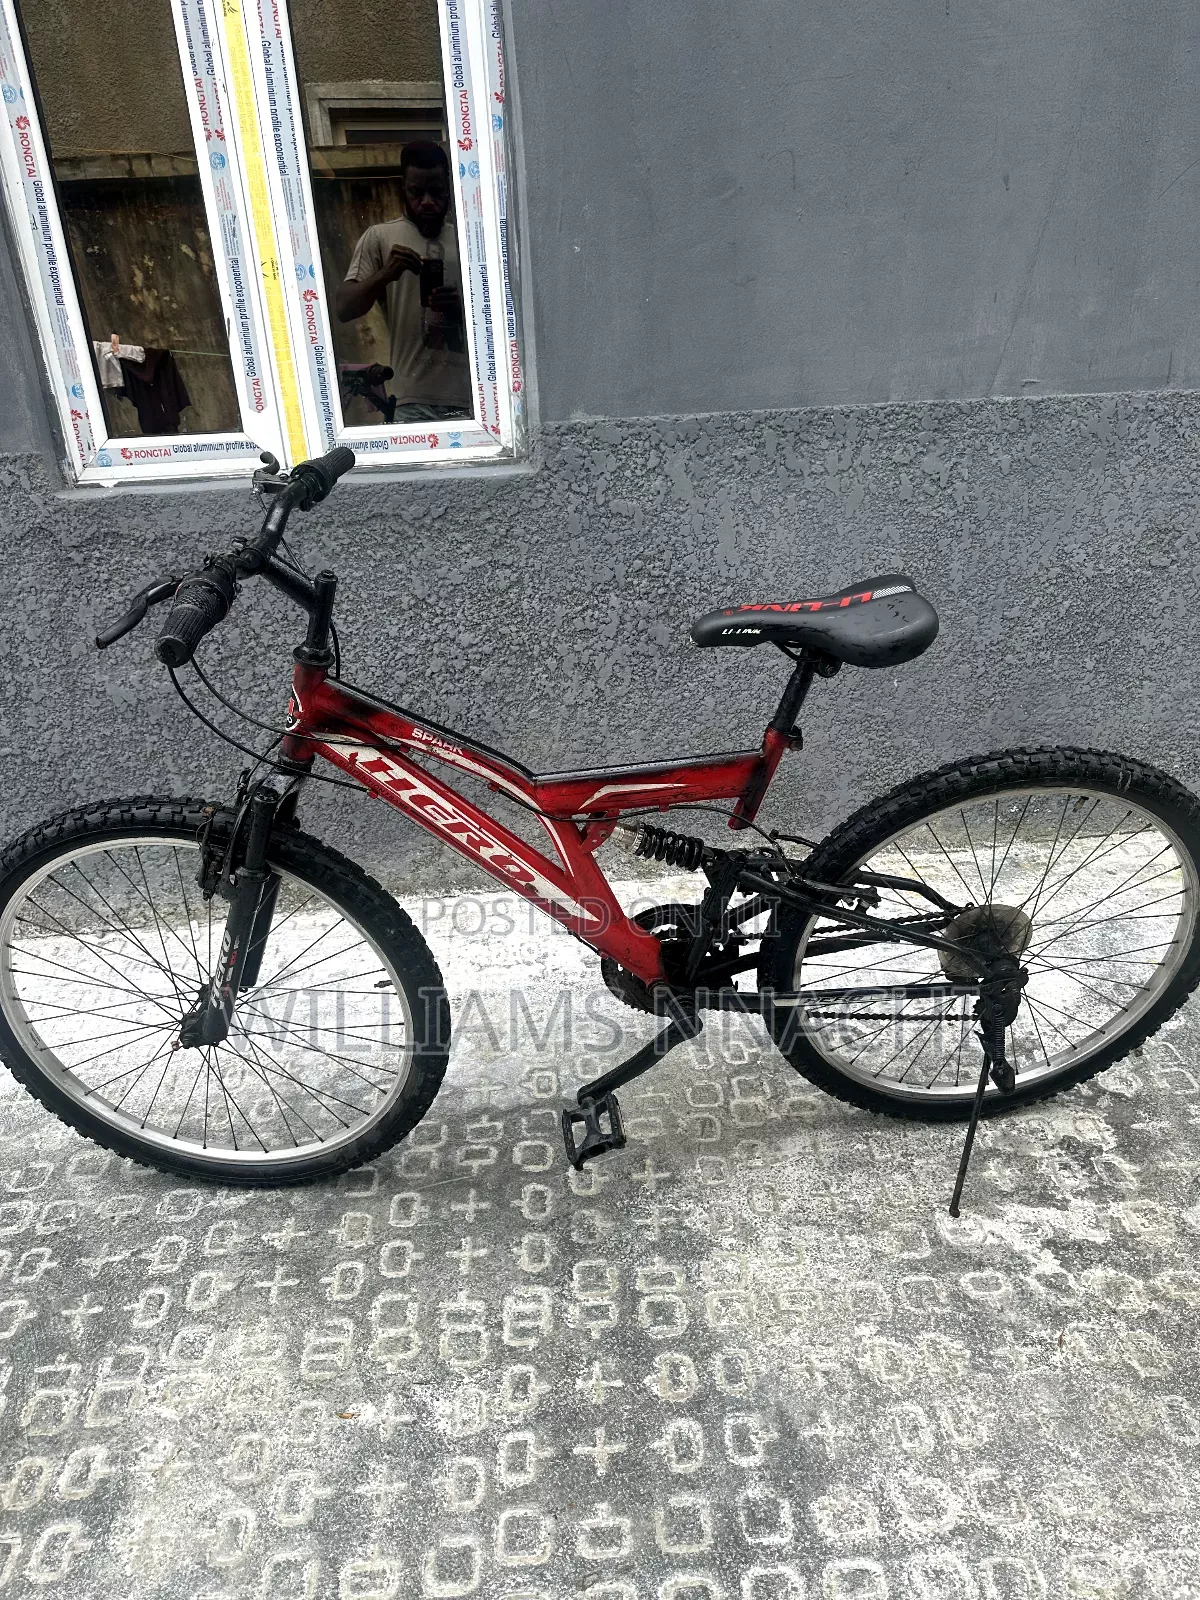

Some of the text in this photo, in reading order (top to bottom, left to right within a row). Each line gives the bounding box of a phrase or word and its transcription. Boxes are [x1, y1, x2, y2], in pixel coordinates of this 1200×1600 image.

[448, 21, 462, 62] aluminium
[264, 67, 278, 107] aluminium
[452, 63, 465, 88] Global
[459, 89, 471, 136] RONGTAI
[18, 132, 65, 306] RONGTAI Global aluminium profile exponential
[231, 257, 265, 414] ONGTAI Global aluminium profile exponential
[305, 304, 318, 345] RONGTAI
[314, 345, 325, 367] Global
[483, 326, 496, 360] aluminium
[510, 339, 520, 379] RONGTAI
[316, 367, 330, 400] aluminium
[319, 401, 333, 422] profile
[134, 448, 172, 459] RONGTAI
[172, 444, 193, 453] Global
[193, 442, 225, 452] aluminium
[225, 441, 245, 452] profile
[369, 440, 389, 451] Global
[390, 434, 426, 445] RONGTAI
[411, 727, 464, 755] SPARK
